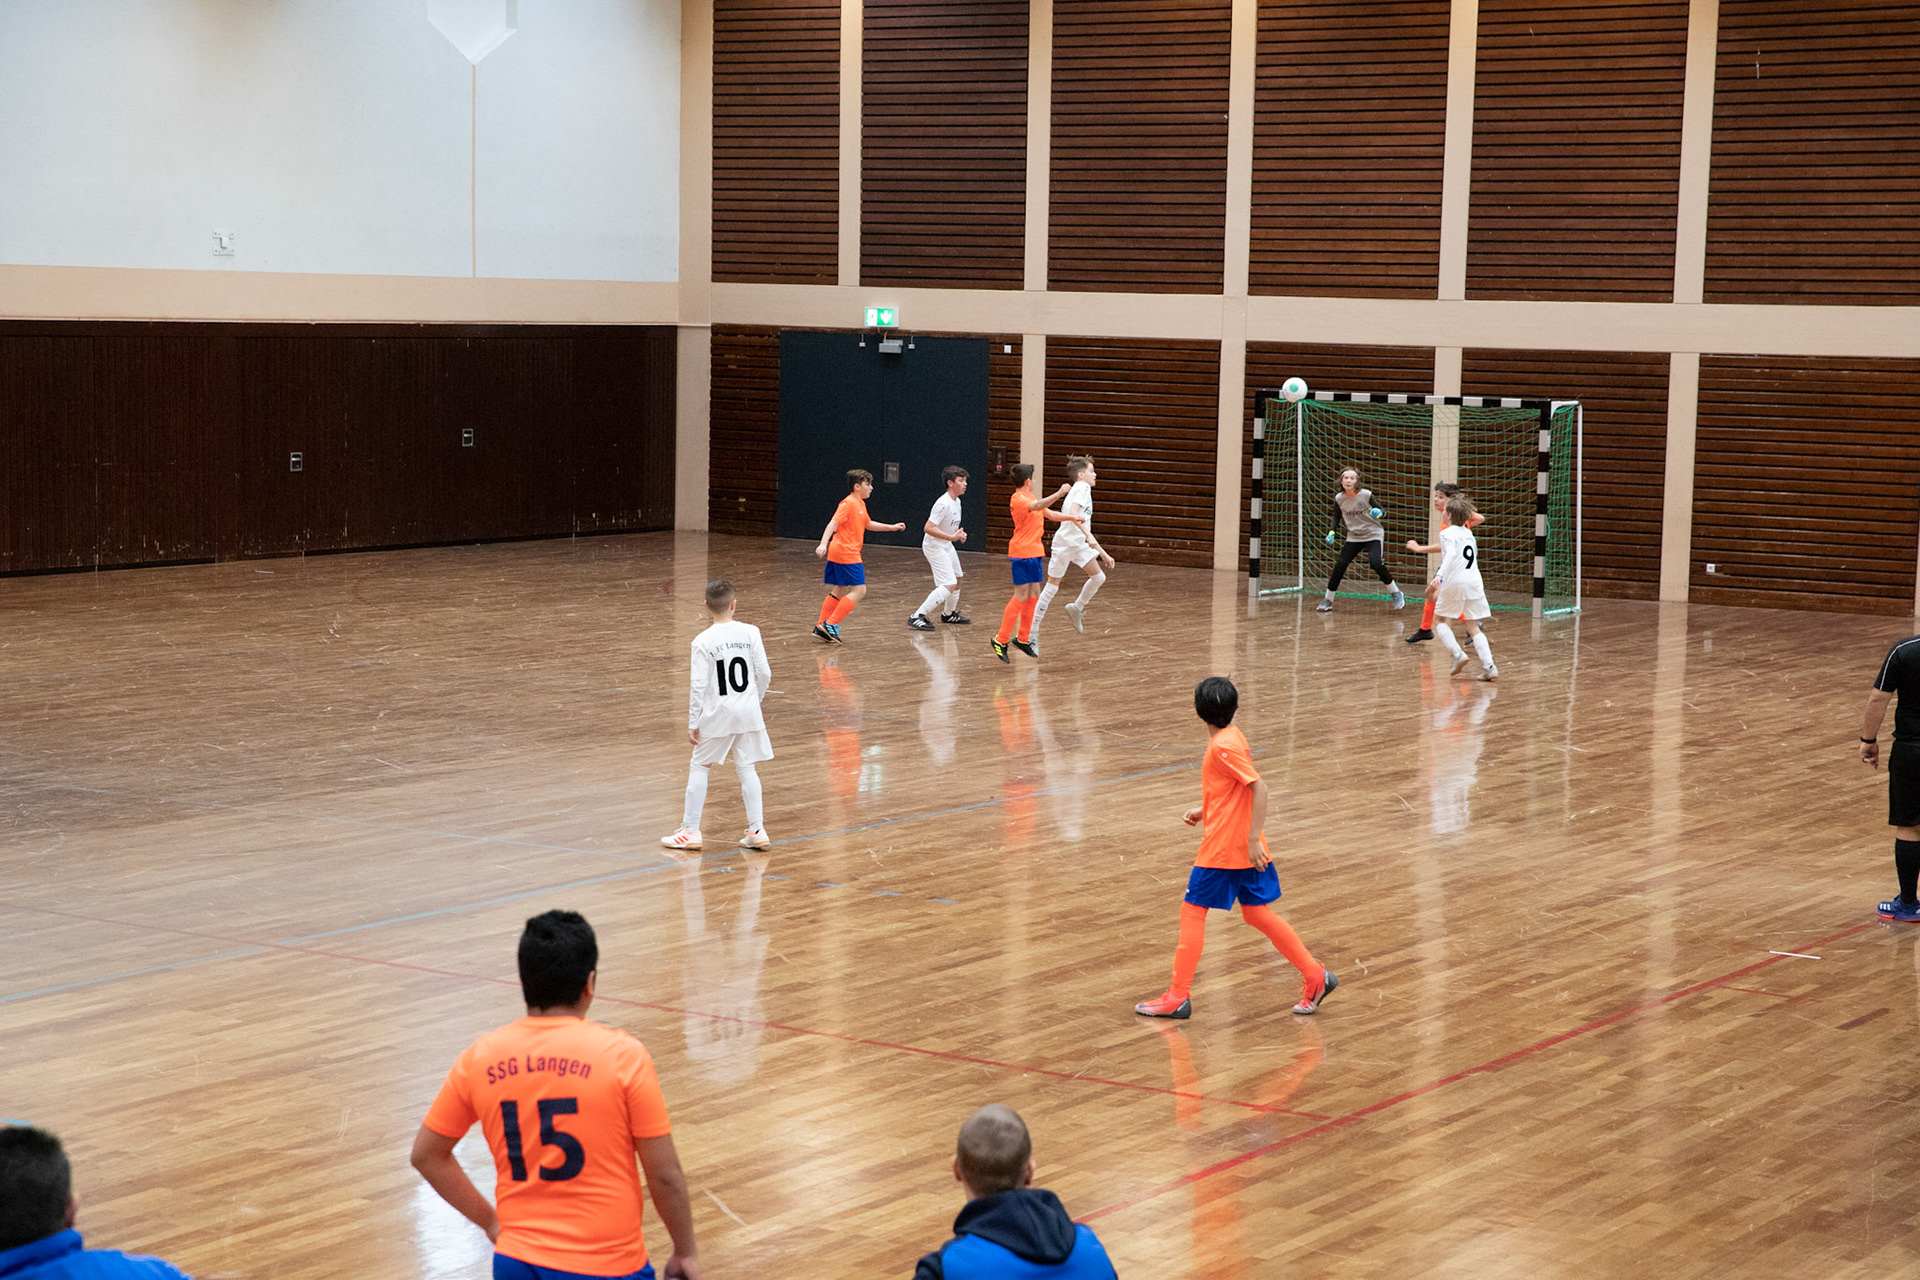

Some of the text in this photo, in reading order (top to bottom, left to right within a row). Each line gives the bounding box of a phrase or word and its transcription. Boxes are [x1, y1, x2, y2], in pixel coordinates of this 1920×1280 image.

[1463, 544, 1475, 570] 9
[715, 643, 726, 653] FC
[725, 642, 751, 650] Langen
[716, 656, 749, 696] 10
[487, 1055, 592, 1084] SSG Langen
[500, 1097, 586, 1182] 15
